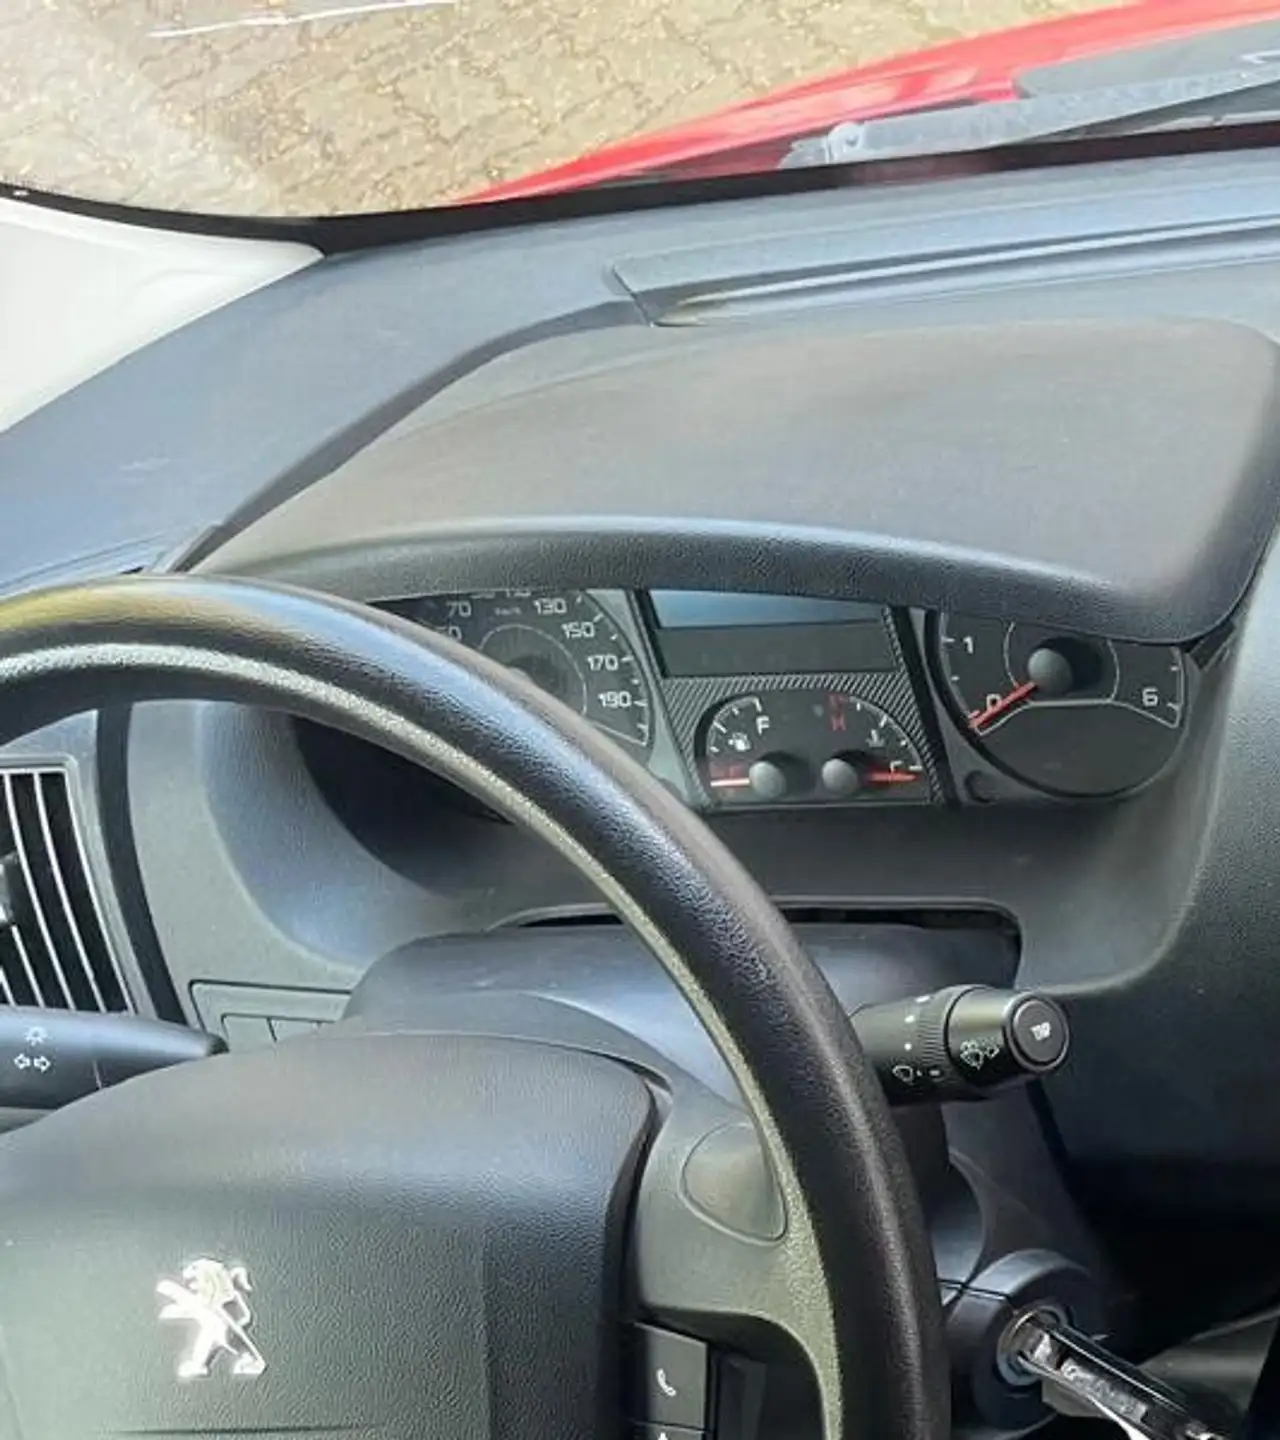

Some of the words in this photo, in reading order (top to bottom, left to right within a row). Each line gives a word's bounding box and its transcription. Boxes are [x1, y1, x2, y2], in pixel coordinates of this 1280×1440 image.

[446, 601, 471, 617] 70
[533, 598, 567, 614] 130
[561, 622, 595, 638] 150
[963, 637, 974, 653] 1
[587, 655, 619, 671] 170
[598, 692, 632, 708] 190
[1142, 687, 1158, 706] 6
[756, 715, 770, 735] F
